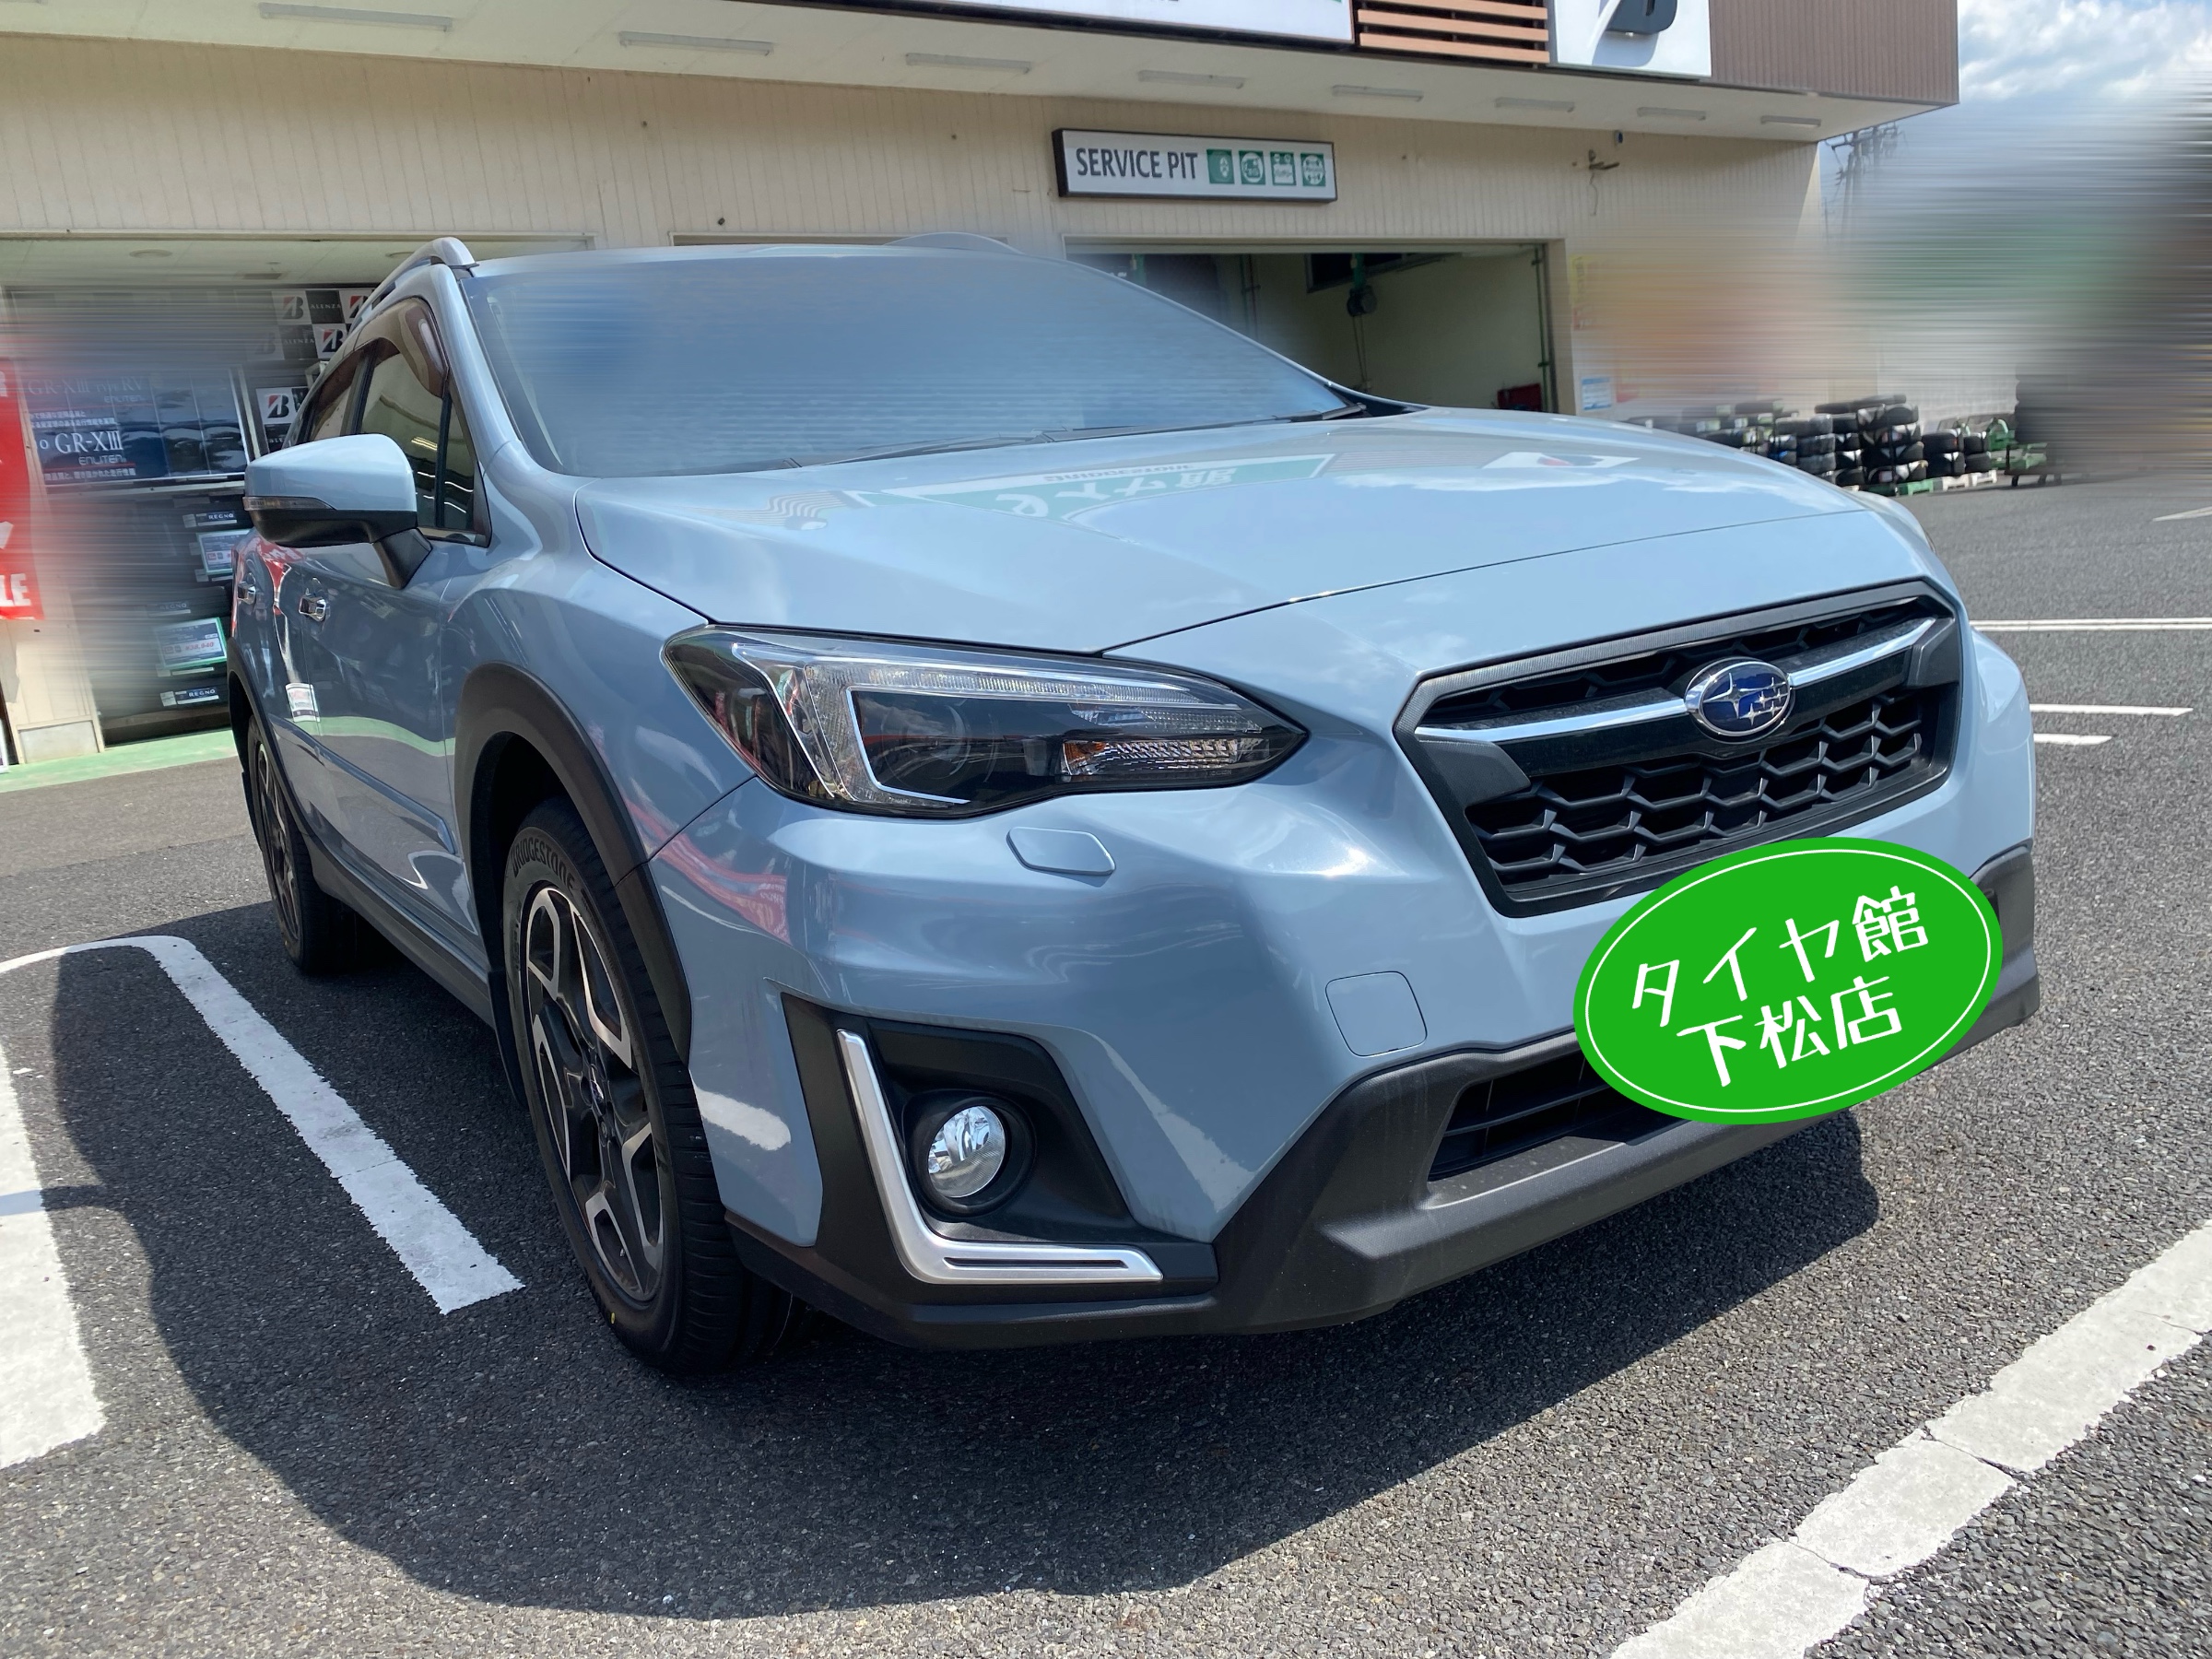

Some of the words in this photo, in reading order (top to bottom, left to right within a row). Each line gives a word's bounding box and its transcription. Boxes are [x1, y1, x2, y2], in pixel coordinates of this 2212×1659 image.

[1076, 147, 1162, 179] SERVICE
[1167, 150, 1198, 180] PIT
[188, 688, 216, 698] REGNO
